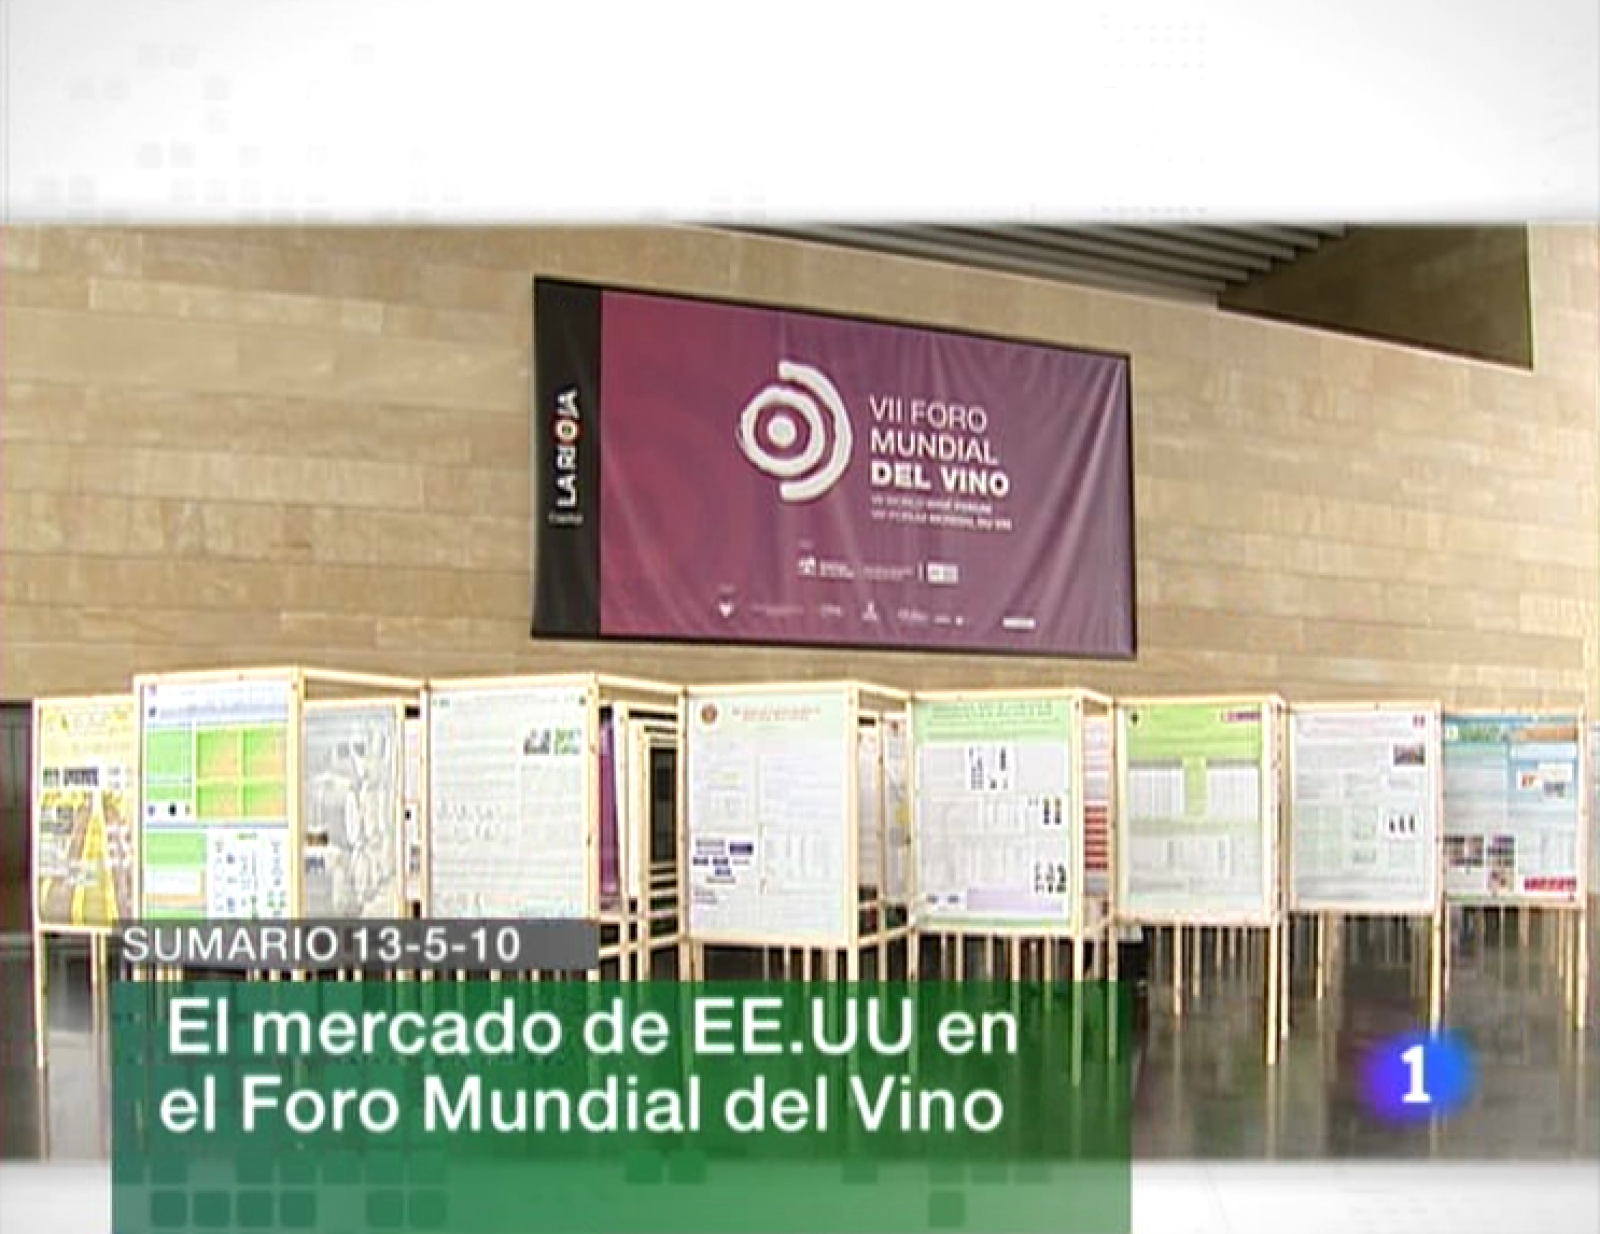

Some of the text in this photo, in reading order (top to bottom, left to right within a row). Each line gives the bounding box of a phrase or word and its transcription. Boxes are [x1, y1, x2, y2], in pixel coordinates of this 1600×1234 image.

[869, 393, 988, 434] VII FORO
[870, 427, 999, 466] MUNDIAL
[870, 461, 1011, 498] DEL VINO
